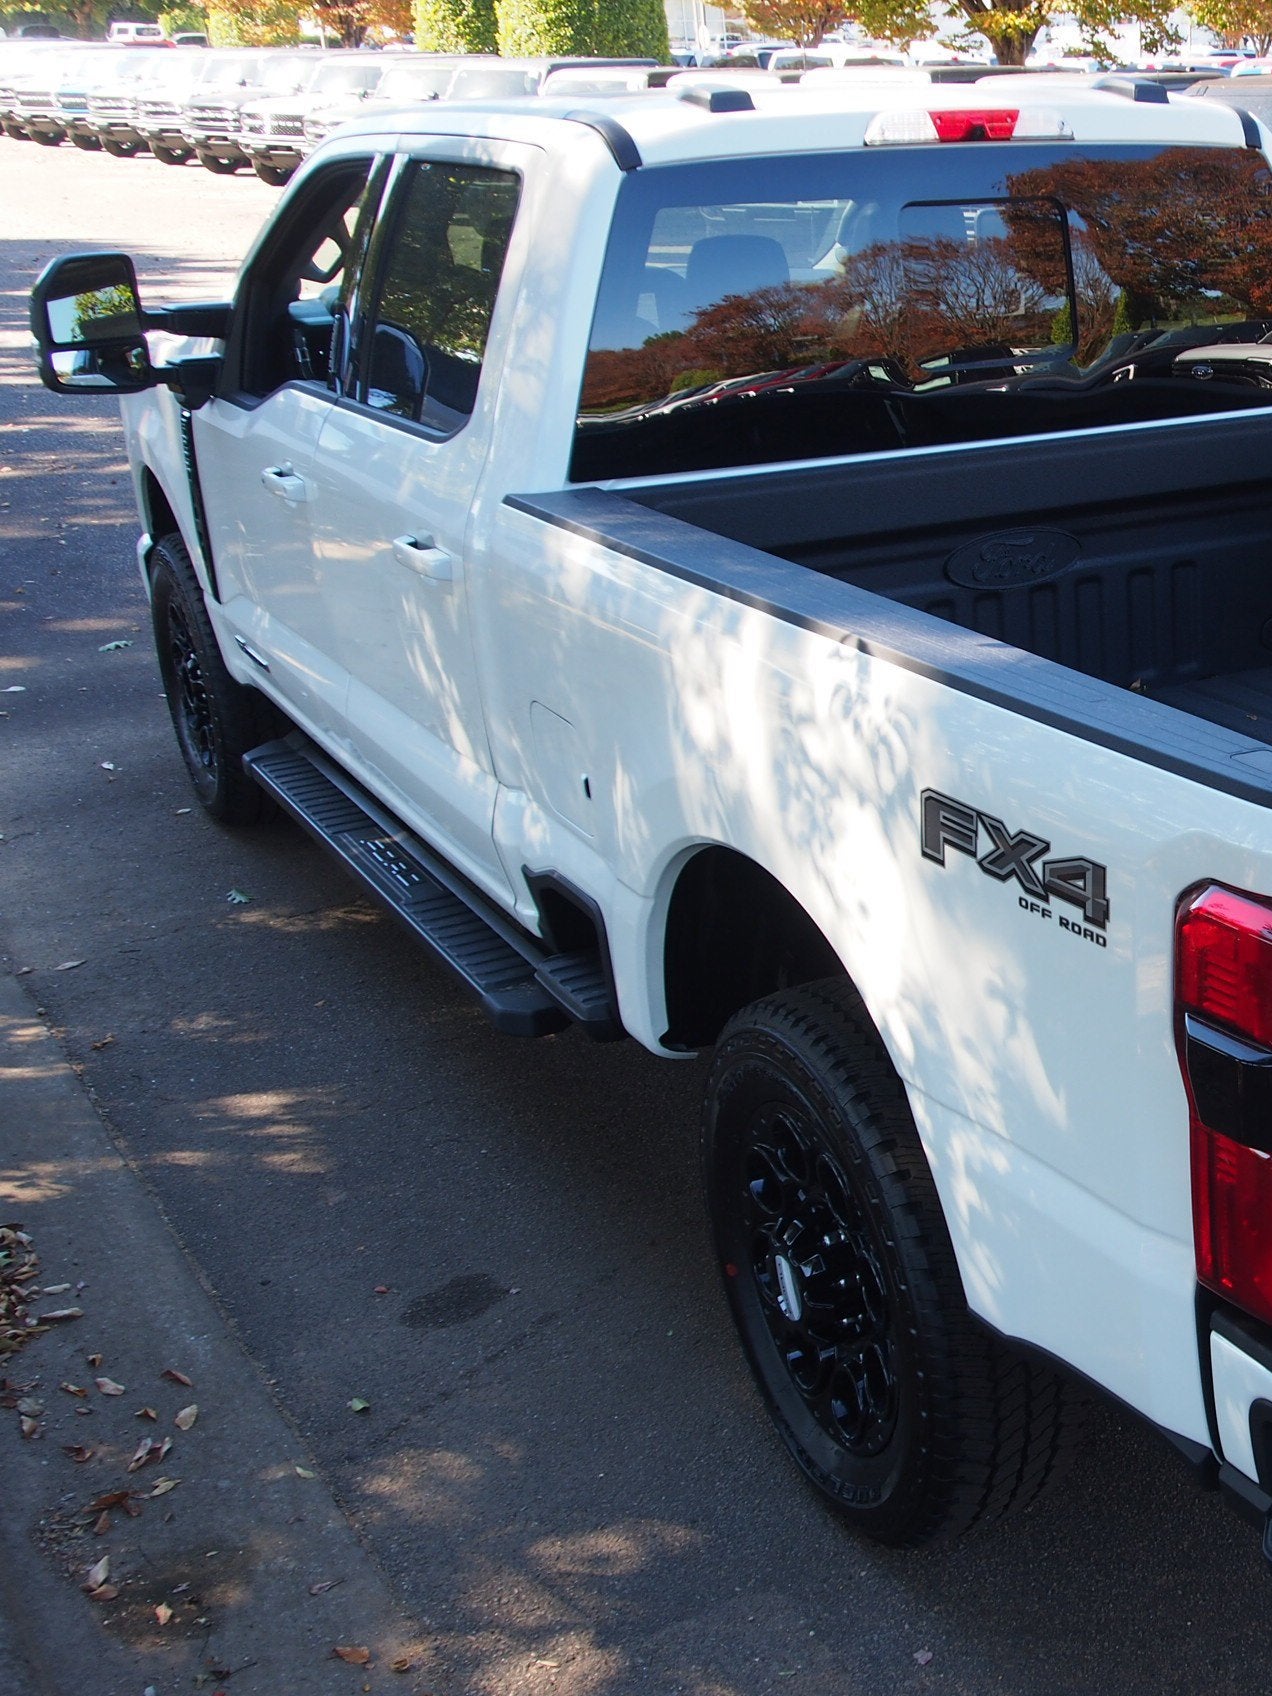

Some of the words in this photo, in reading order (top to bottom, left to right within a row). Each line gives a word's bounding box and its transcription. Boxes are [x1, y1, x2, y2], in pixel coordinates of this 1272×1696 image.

[920, 786, 1110, 932] FX4
[1018, 896, 1053, 920] OFF
[1058, 914, 1108, 948] ROAD
